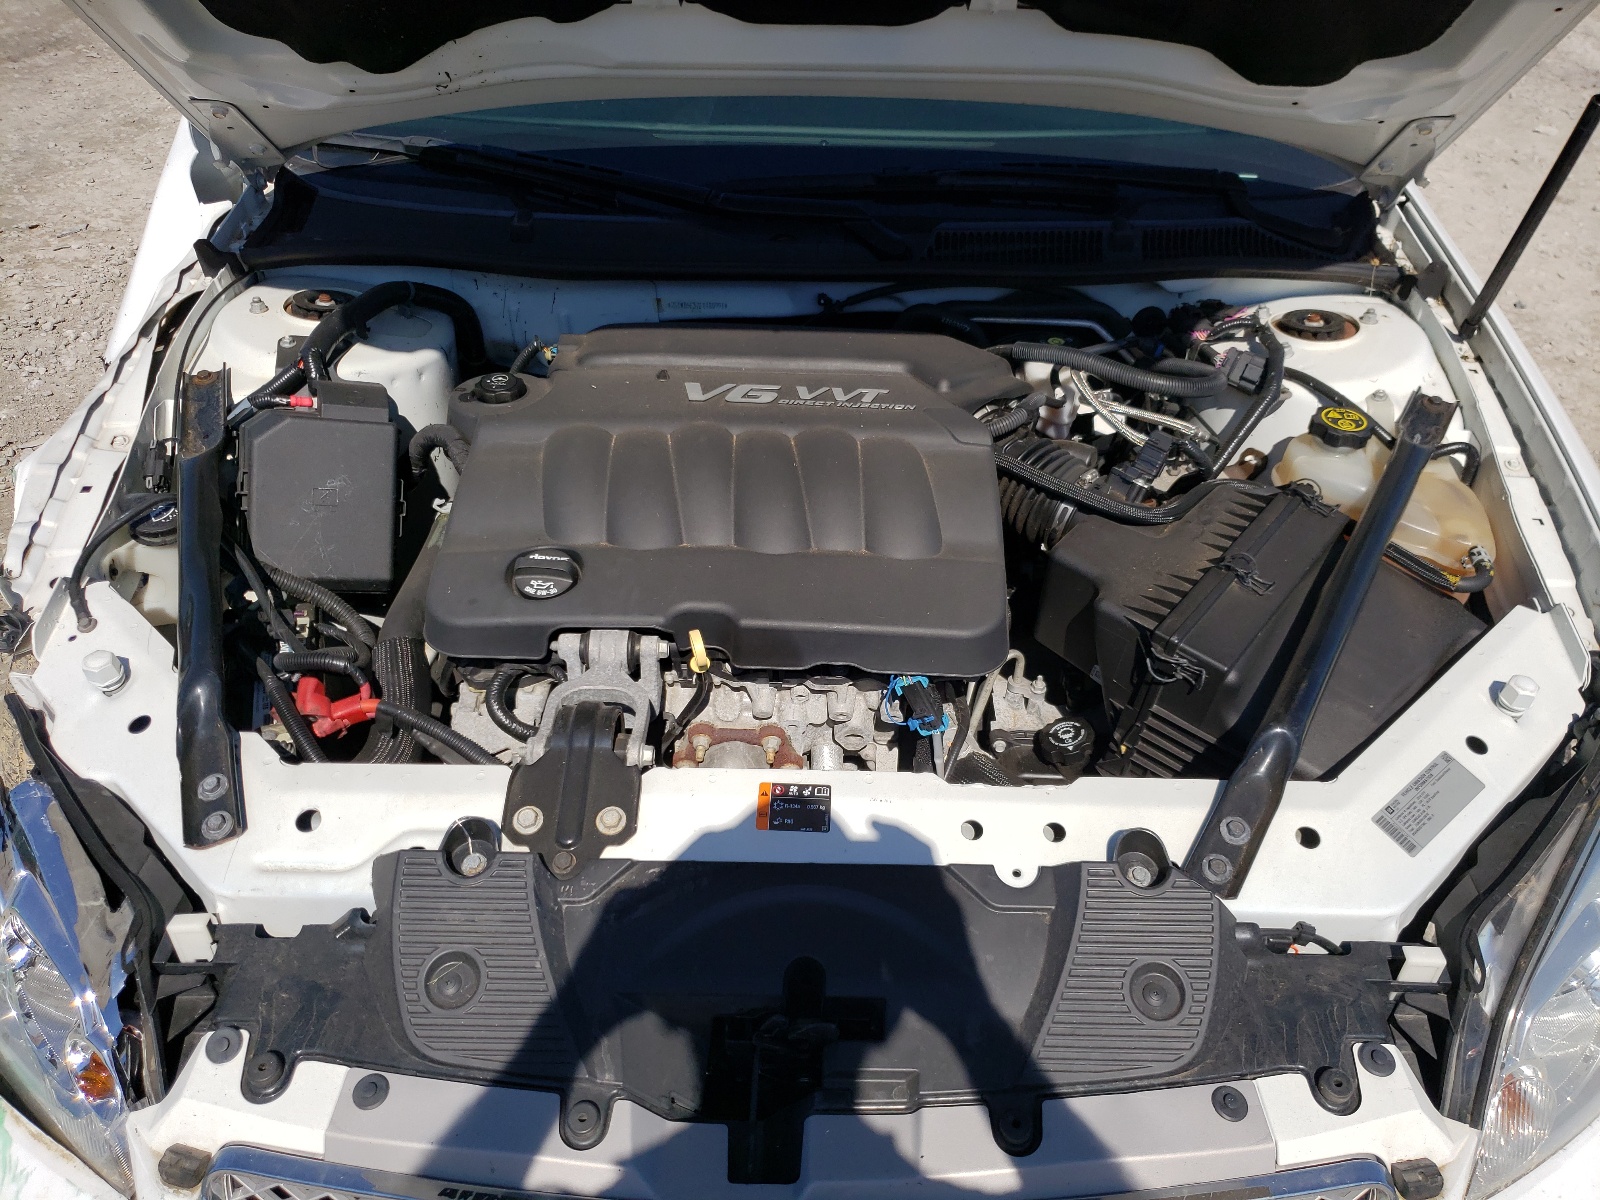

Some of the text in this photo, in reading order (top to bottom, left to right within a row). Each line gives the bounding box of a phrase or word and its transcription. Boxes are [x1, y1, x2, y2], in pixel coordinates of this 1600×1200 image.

[685, 382, 890, 403] V6 VVT
[777, 399, 917, 410] DIRECT INJECTION
